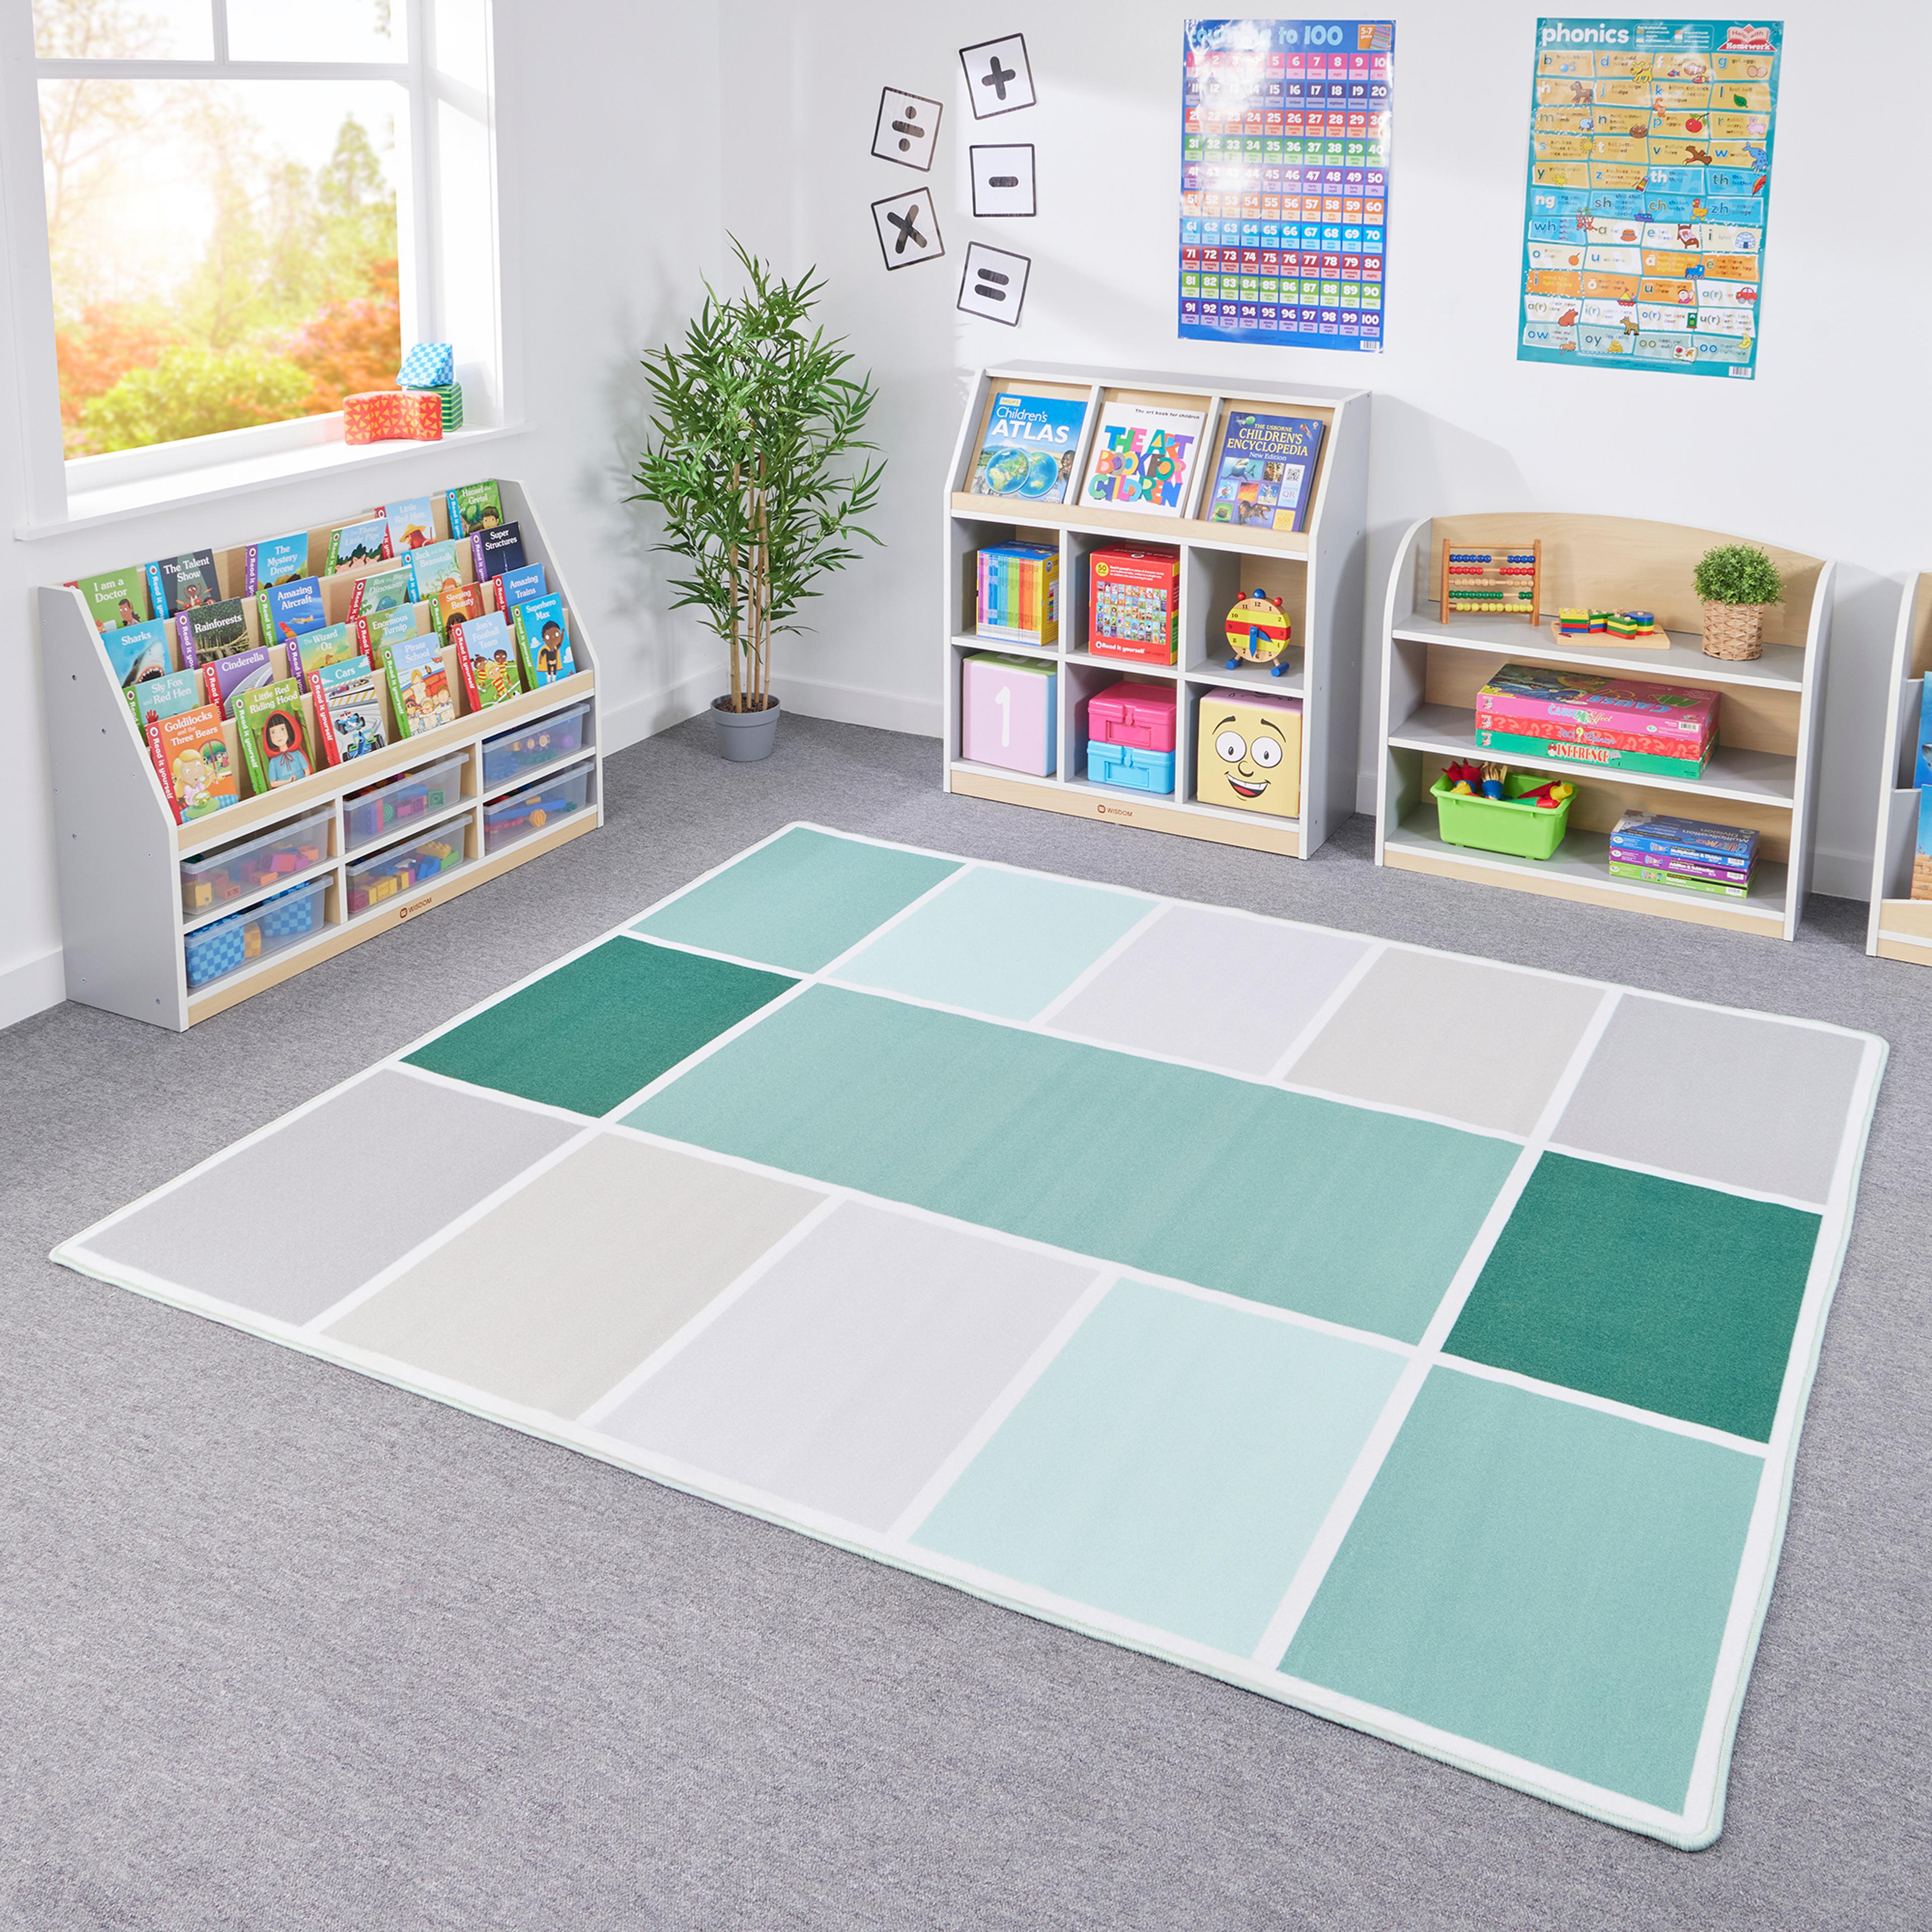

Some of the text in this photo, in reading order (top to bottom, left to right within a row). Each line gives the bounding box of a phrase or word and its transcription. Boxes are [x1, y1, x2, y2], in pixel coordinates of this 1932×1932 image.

[1278, 26, 1298, 44] to
[1304, 25, 1343, 46] 100
[1542, 23, 1629, 46] phonics
[1732, 30, 1764, 39] Help with
[1726, 42, 1771, 50] Homework
[1544, 54, 1552, 65] b
[1600, 55, 1610, 66] d
[1718, 57, 1728, 70] g
[1536, 195, 1555, 209] ng
[1595, 197, 1611, 208] sh
[1649, 199, 1666, 210] ch
[1711, 203, 1729, 213] zh
[1534, 220, 1556, 231] wh
[1186, 249, 1380, 269] 71 72 73 74 75 76 77 78 79 80
[1185, 302, 1379, 325] 91 92 93 94 95 96 97 98 99 100
[1528, 331, 1549, 339] ow
[1585, 335, 1602, 346] oy
[997, 406, 1048, 423] Children's
[991, 419, 1070, 443] ATLAS
[1266, 425, 1293, 433] USBORNE
[1104, 425, 1194, 459] THE ART
[1239, 428, 1303, 445] CHILDREN'S
[1227, 438, 1309, 456] ENCYCLOPEDIA
[1264, 453, 1286, 461] Edition
[1095, 450, 1186, 484] BOOK FOR
[462, 486, 485, 497] Hansel
[468, 494, 488, 505] Gretel
[490, 529, 509, 541] Super
[275, 545, 291, 555] The
[485, 536, 518, 551] Structures
[164, 556, 210, 575] The Talent
[267, 553, 298, 567] Mystery
[270, 564, 294, 576] Drone
[1097, 564, 1107, 572] 50
[177, 571, 201, 583] Show
[510, 575, 539, 589] Amazing
[94, 582, 99, 592] I
[101, 581, 116, 591] am
[277, 586, 313, 601] Amazing
[368, 581, 404, 596] Dinosaur
[515, 587, 536, 599] Trains
[95, 589, 128, 603] Doctor
[281, 596, 312, 610] Aircraft
[445, 589, 472, 603] Sleeping
[451, 596, 474, 610] Beauty
[525, 599, 556, 614] Superhero
[372, 614, 409, 630] Enormous
[535, 610, 551, 621] Max
[194, 614, 243, 633] Rainforests
[383, 624, 408, 636] Turnip
[475, 620, 493, 631] Jon's
[121, 631, 152, 646] Sharks
[312, 629, 338, 643] Wizard
[471, 626, 501, 641] Football
[320, 640, 332, 652] Oz
[405, 641, 427, 654] Pirate
[479, 638, 499, 650] Team
[516, 617, 524, 635] Read
[521, 641, 532, 668] yourself
[222, 653, 264, 672] Cinderella
[405, 649, 431, 663] School
[335, 667, 356, 679] Cars
[151, 678, 184, 694] Sly Fox
[153, 693, 172, 705] Red
[173, 687, 192, 700] Hen
[254, 684, 290, 703] Little Red
[249, 691, 298, 714] Riding Hood
[314, 684, 325, 704] Read
[320, 711, 334, 742] yourself
[995, 685, 1011, 748] 1
[164, 711, 213, 733] Goldilocks
[170, 726, 218, 747] Three Bears
[177, 729, 188, 737] and
[239, 709, 247, 730] Read
[245, 735, 259, 769] yourself
[1557, 743, 1610, 764] INFERENCE
[152, 738, 174, 800] Read it yourself
[1107, 808, 1133, 817] WISDOM
[408, 897, 432, 913] WISDOM
